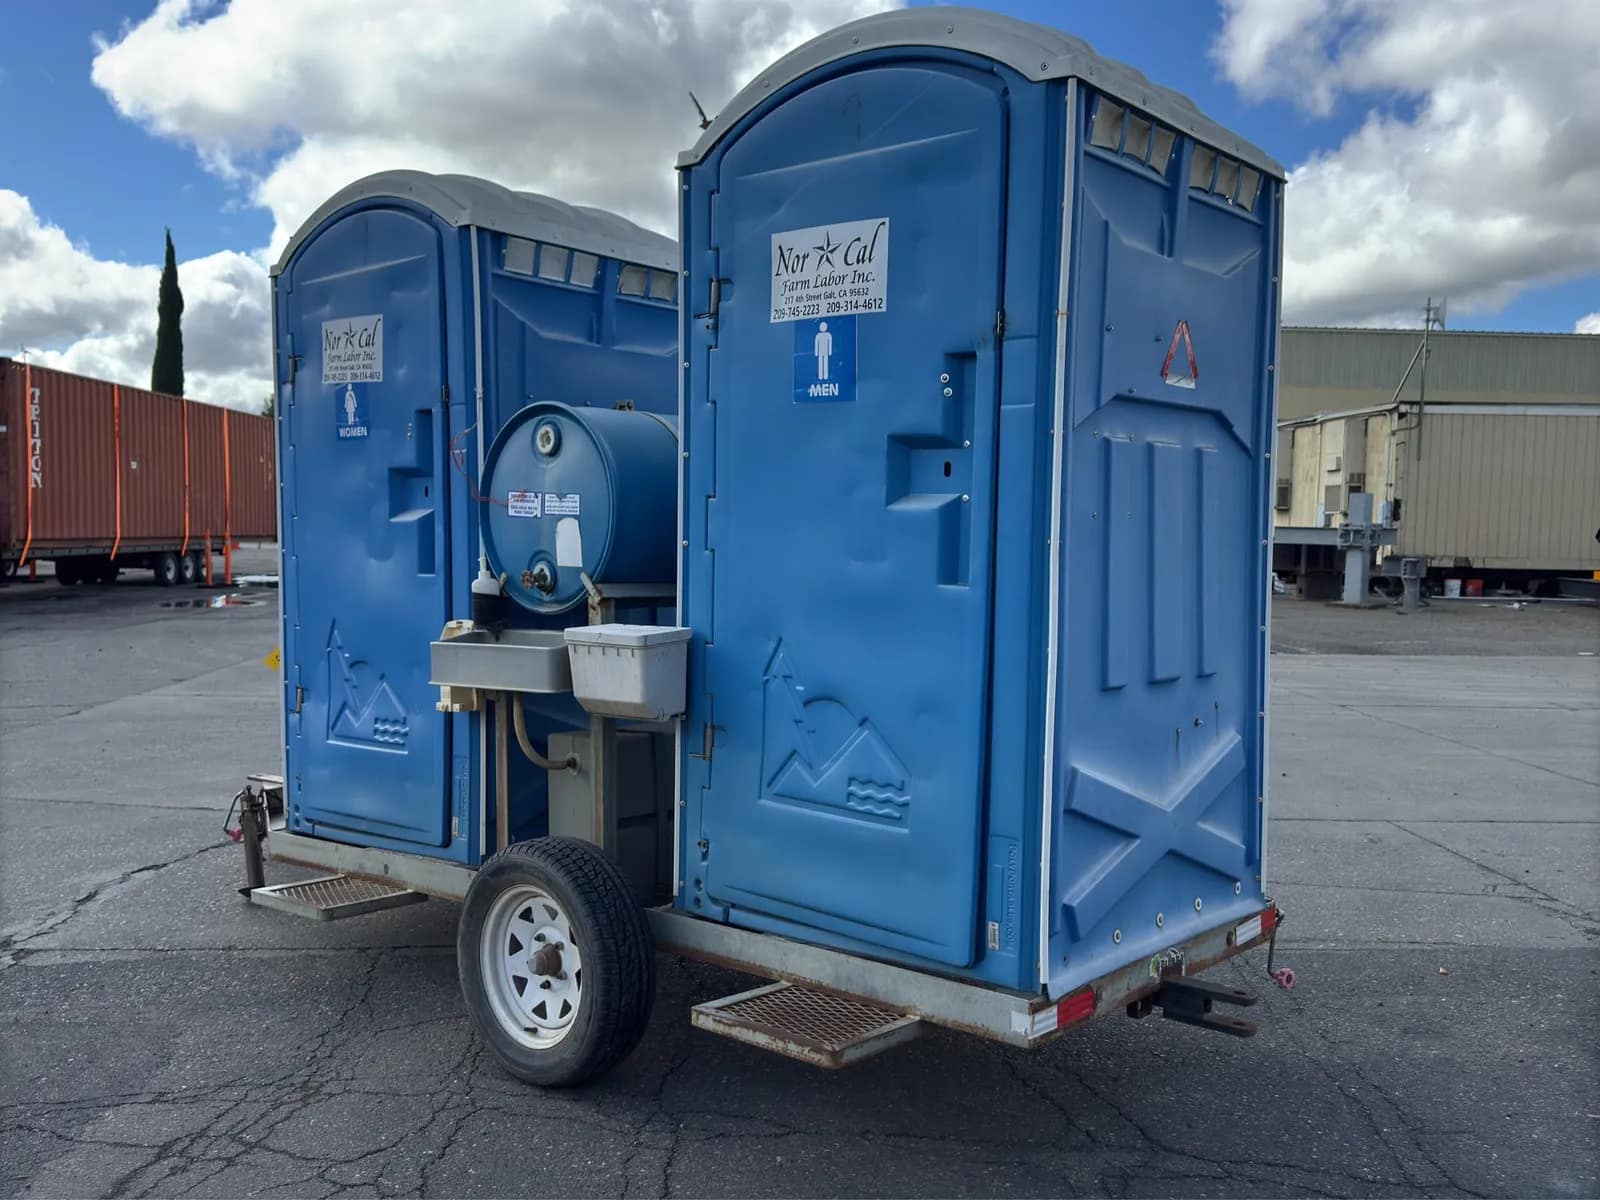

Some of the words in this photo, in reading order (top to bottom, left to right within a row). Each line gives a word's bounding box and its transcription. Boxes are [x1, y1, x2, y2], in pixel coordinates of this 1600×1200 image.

[775, 244, 810, 277] Nor
[844, 221, 886, 267] Cal
[781, 279, 811, 297] Farm
[813, 270, 849, 290] Labor
[851, 269, 876, 285] Inc.
[784, 296, 794, 305] 217
[795, 294, 805, 302] 4th
[806, 292, 822, 302] Street
[838, 289, 848, 298] CA
[849, 287, 870, 297] 95632
[773, 303, 820, 320] 209-745-2223
[826, 297, 884, 314] 209-314-4612
[324, 328, 341, 351] Nor
[358, 318, 382, 348] Cal
[809, 383, 839, 397] MEN
[339, 426, 367, 437] WOMEN
